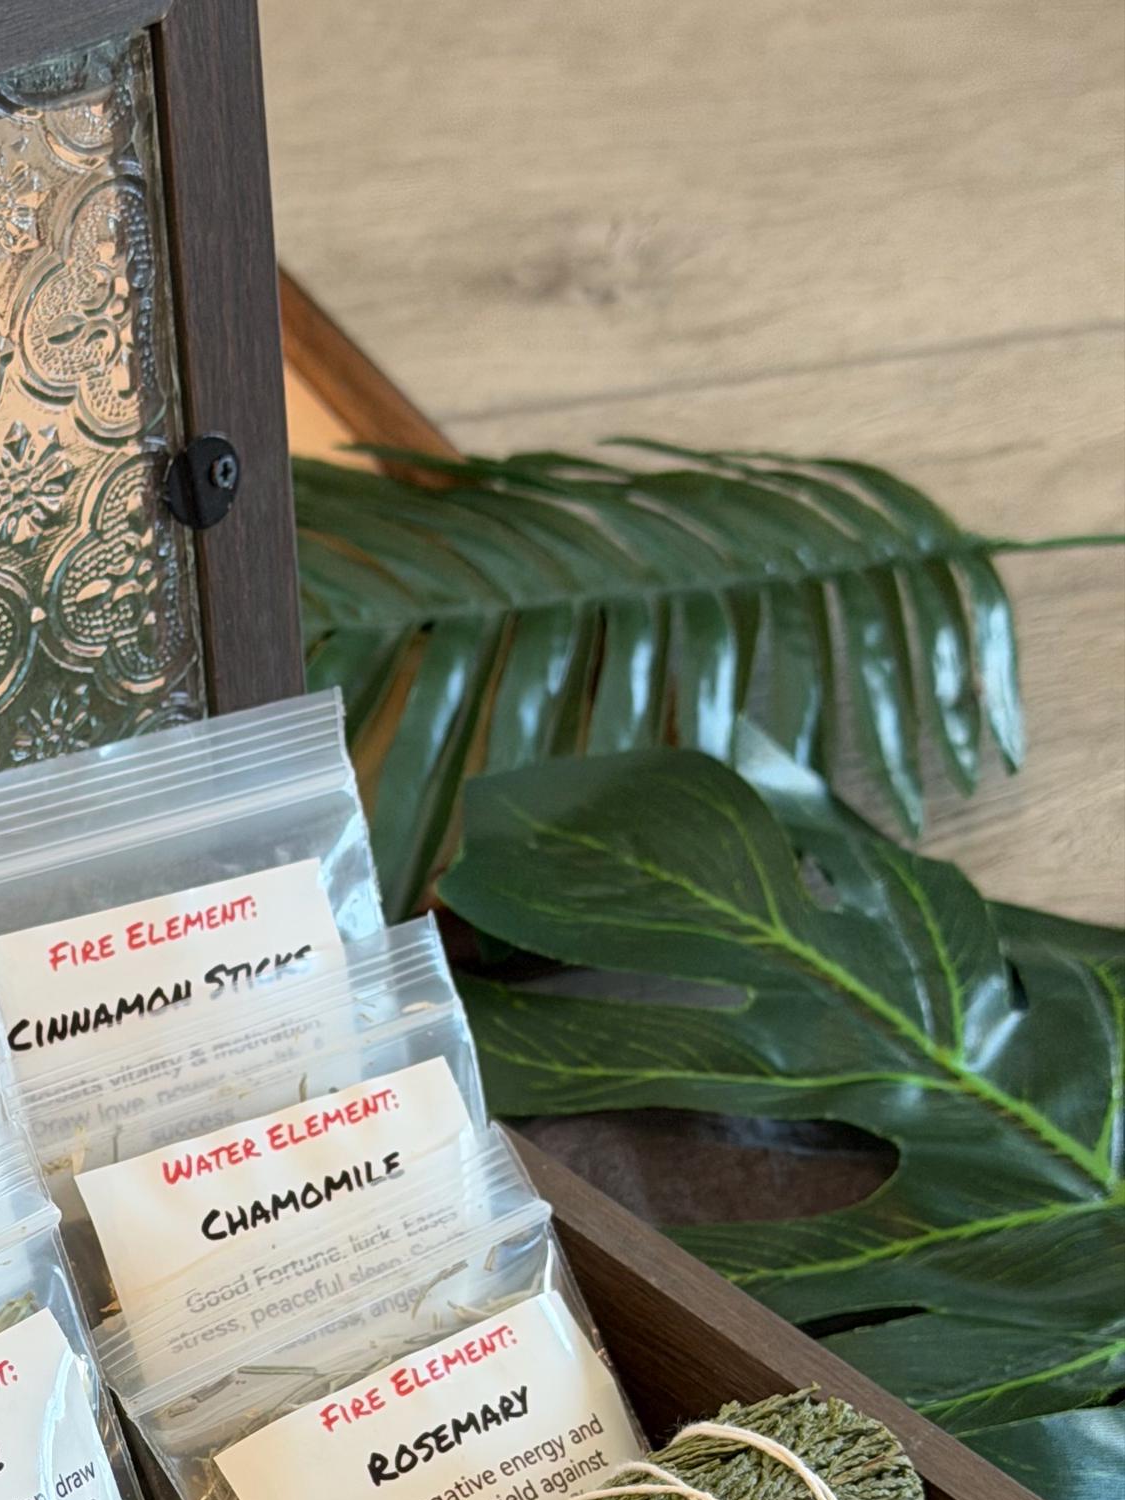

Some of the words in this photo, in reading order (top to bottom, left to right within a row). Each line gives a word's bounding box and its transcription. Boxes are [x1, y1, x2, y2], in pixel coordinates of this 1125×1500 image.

[49, 934, 115, 971] FIRE
[126, 895, 258, 949] ELEMENT:
[7, 980, 192, 1053] CINNAMON
[204, 944, 315, 997] STICKS
[162, 1137, 262, 1186] WATER
[268, 1088, 400, 1150] ELEMENT:
[200, 1151, 406, 1242] CHAMOMILE
[319, 1387, 386, 1432] FIRE
[389, 1325, 518, 1397] ELEMENT:
[56, 1460, 96, 1498] draw
[366, 1386, 530, 1487] ROSEMARY
[499, 1433, 566, 1480] energy
[568, 1413, 605, 1446] and
[540, 1448, 609, 1494] against
